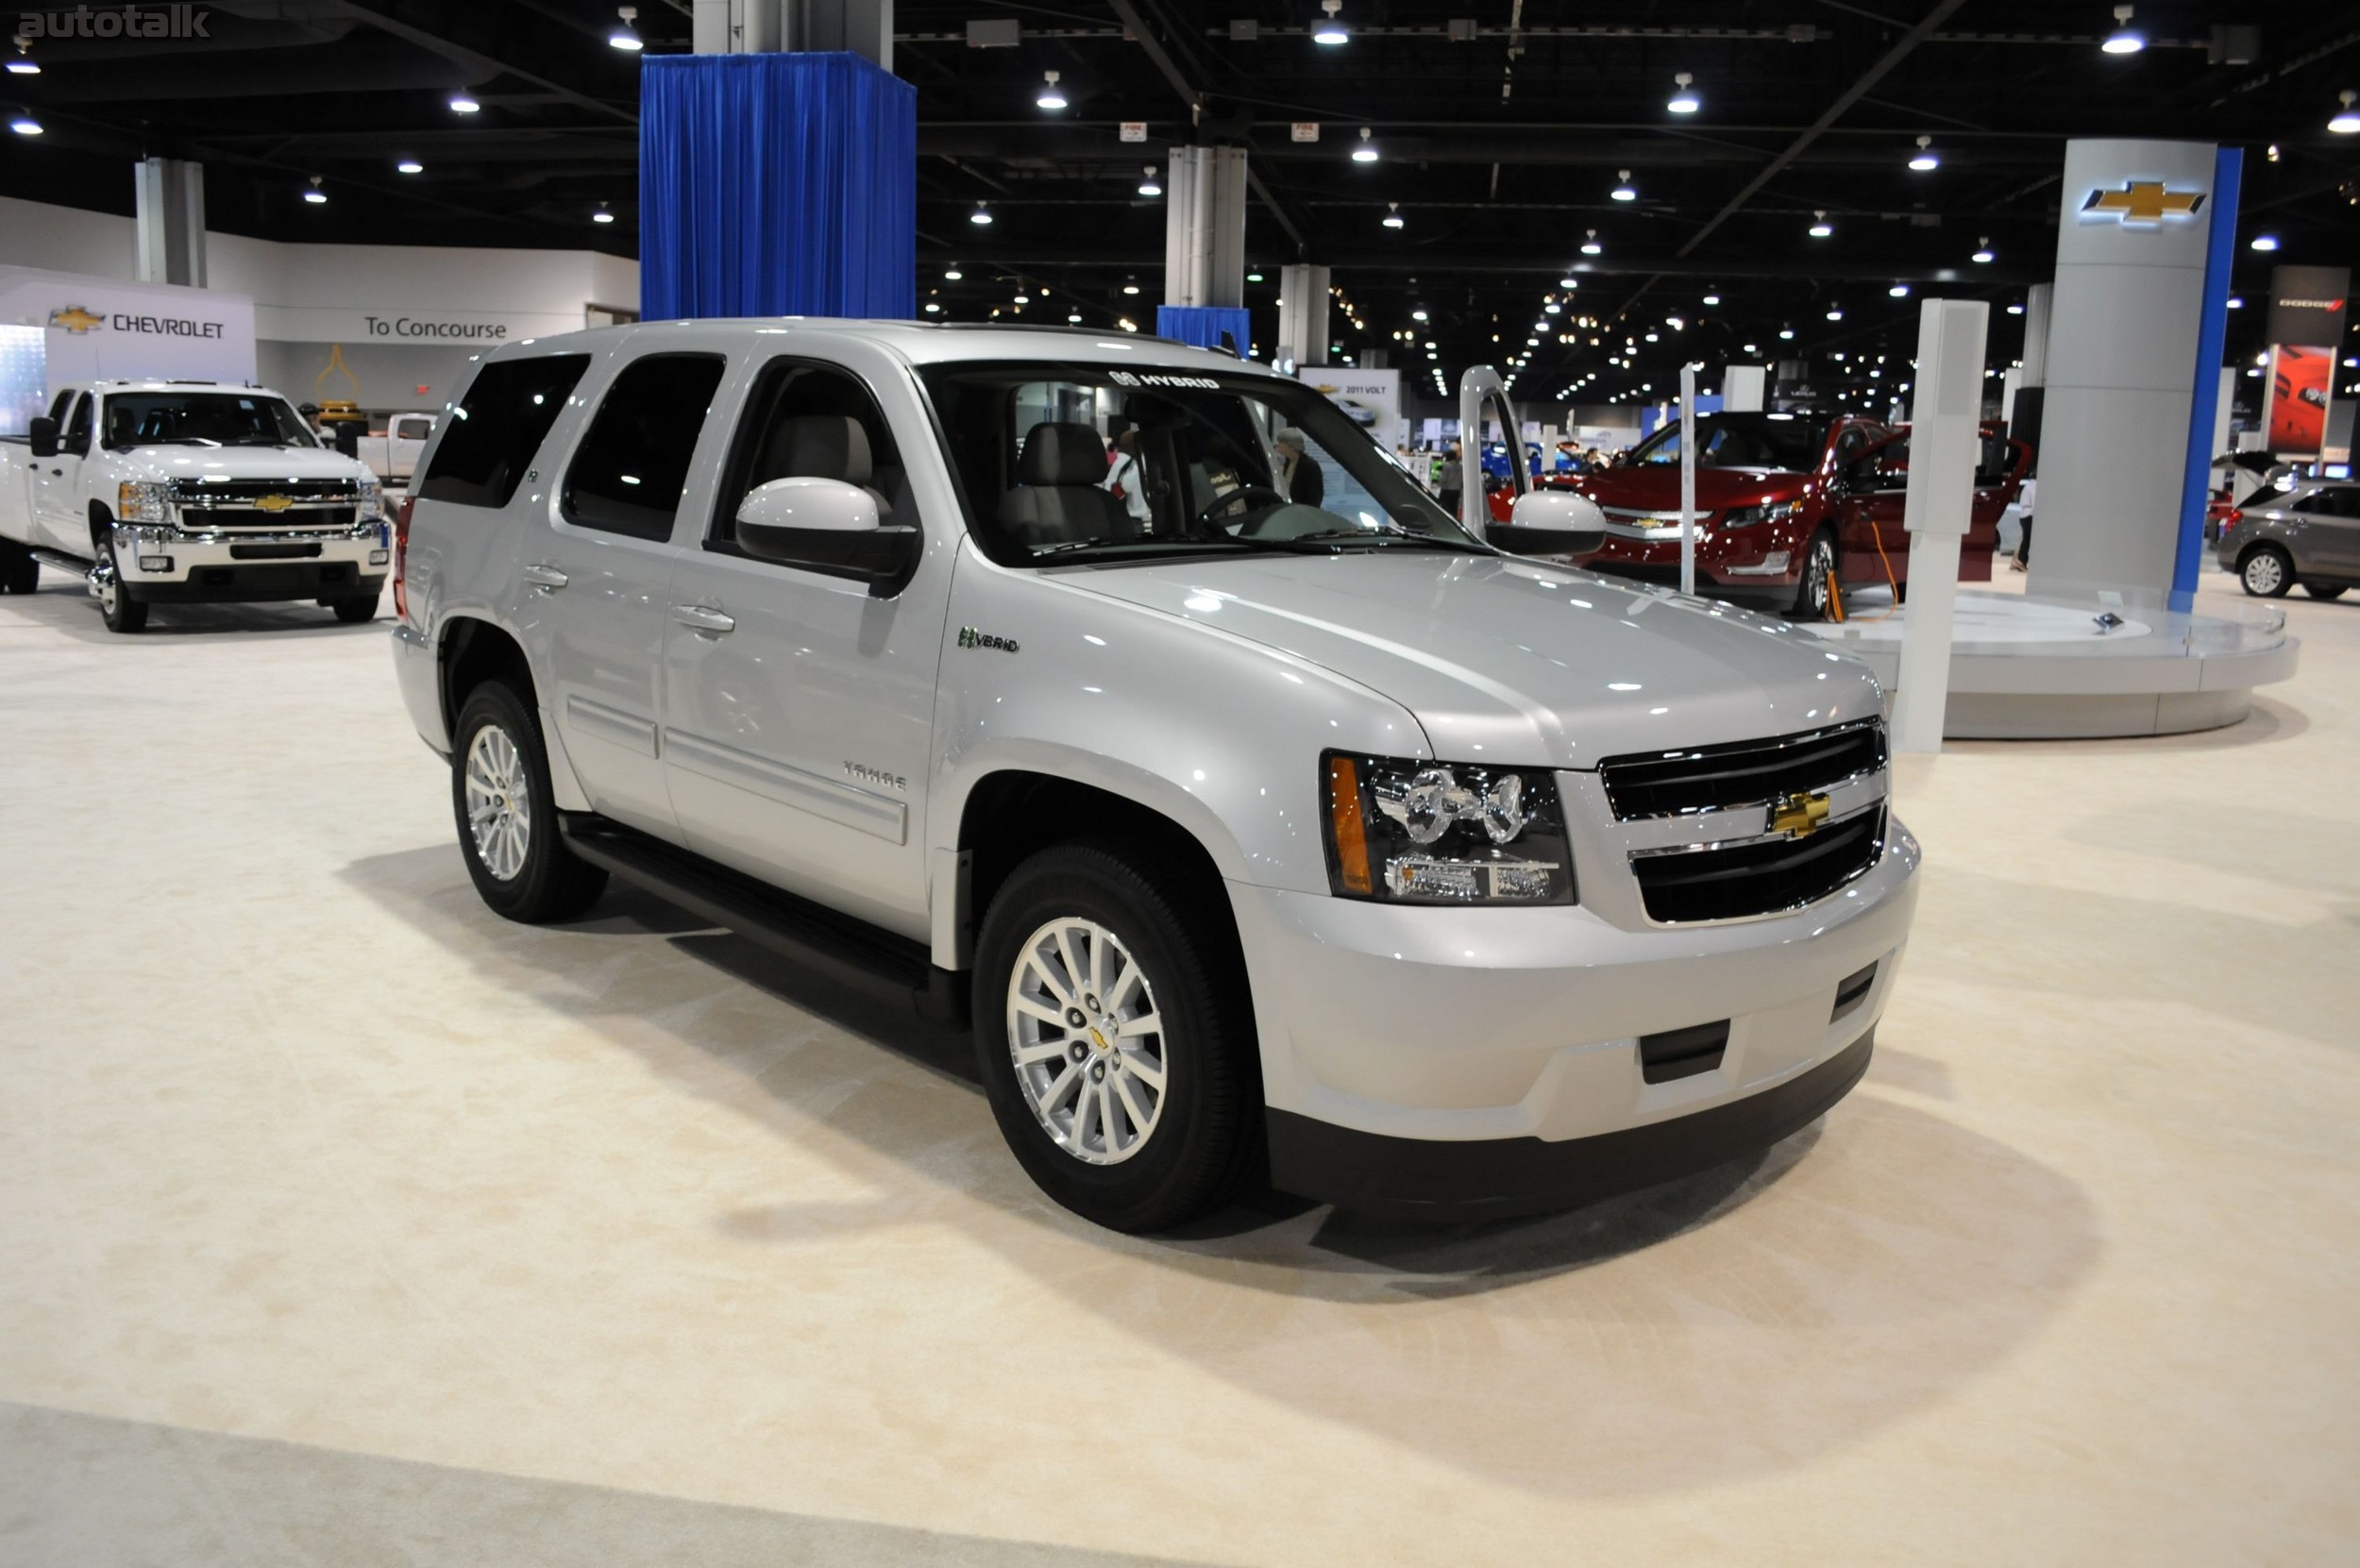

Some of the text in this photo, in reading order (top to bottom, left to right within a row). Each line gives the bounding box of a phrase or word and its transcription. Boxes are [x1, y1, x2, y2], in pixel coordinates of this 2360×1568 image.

[113, 314, 224, 339] CHEVROLET
[364, 316, 507, 338] To Concourse
[1139, 374, 1221, 389] HYBRID
[843, 760, 907, 792] TAHOE
